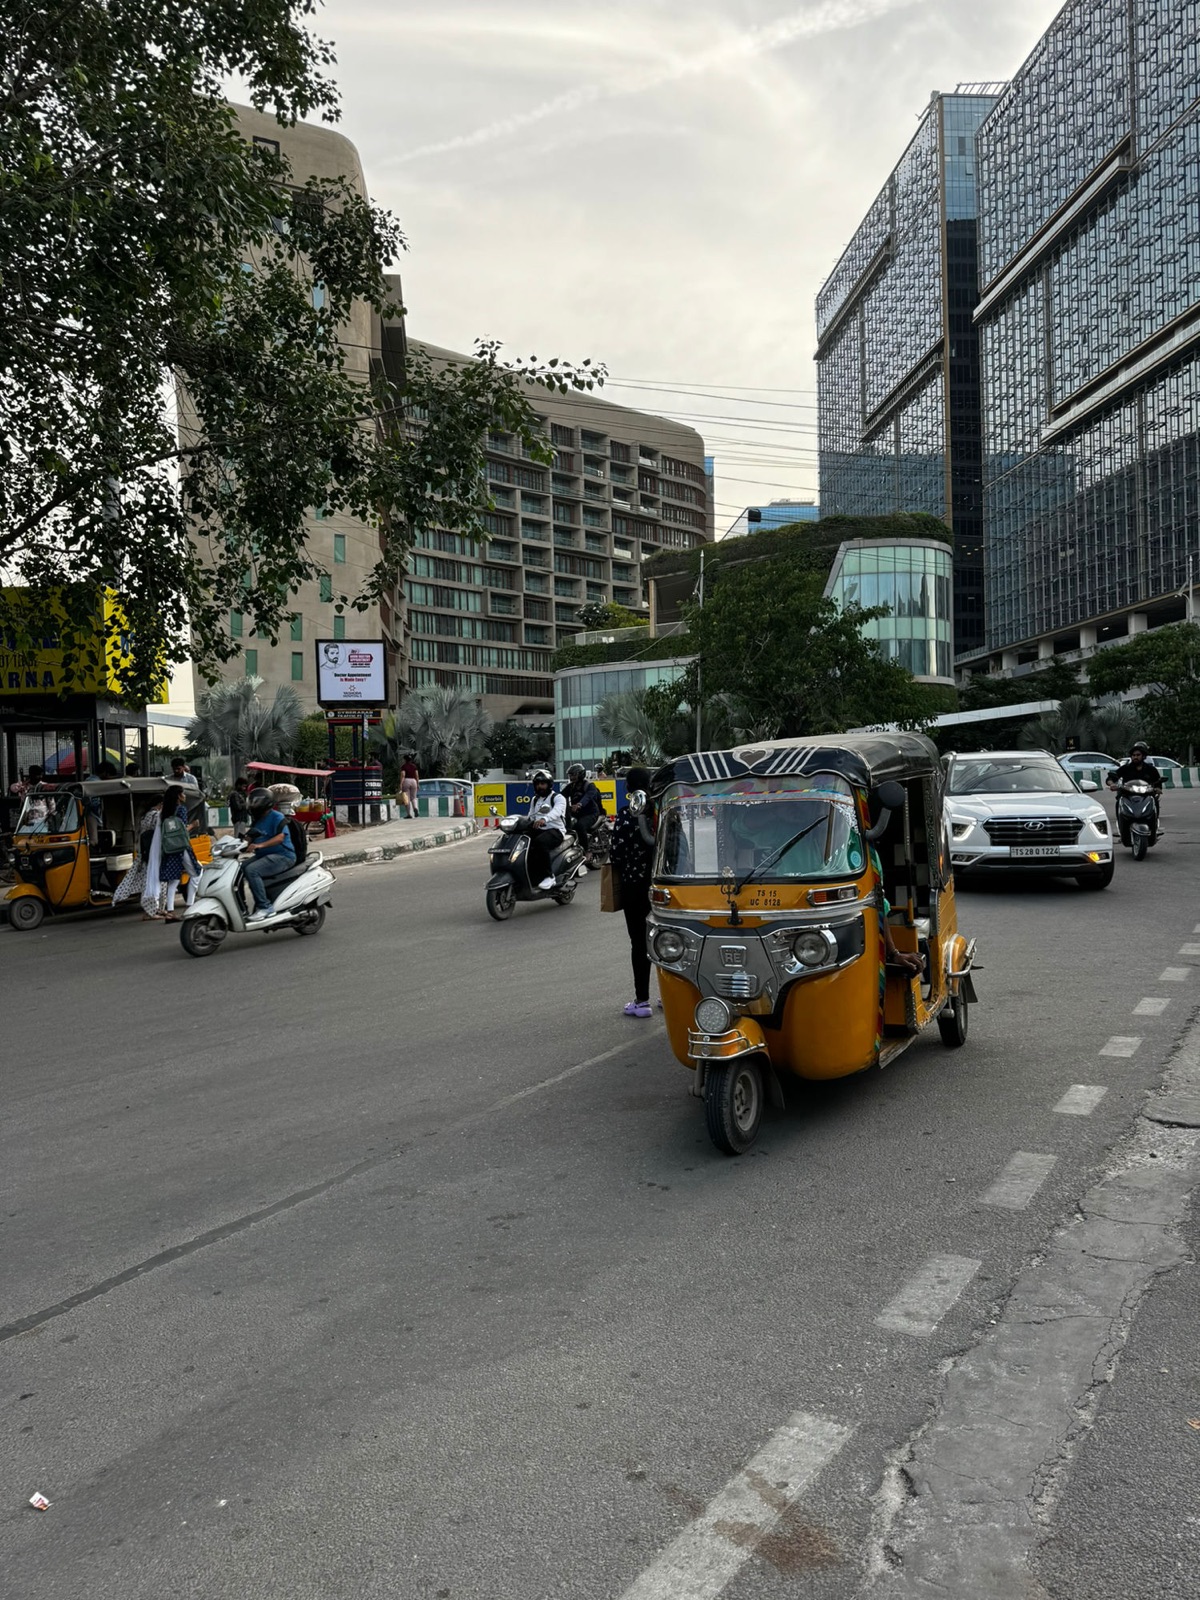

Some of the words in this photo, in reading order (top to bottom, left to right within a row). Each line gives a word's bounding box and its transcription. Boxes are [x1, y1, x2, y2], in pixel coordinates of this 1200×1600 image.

[0, 671, 55, 688] RNA
[1041, 847, 1059, 855] 1224
[757, 889, 766, 897] TS
[750, 898, 759, 906] UC
[764, 898, 781, 906] 8128
[725, 952, 742, 963] RE
